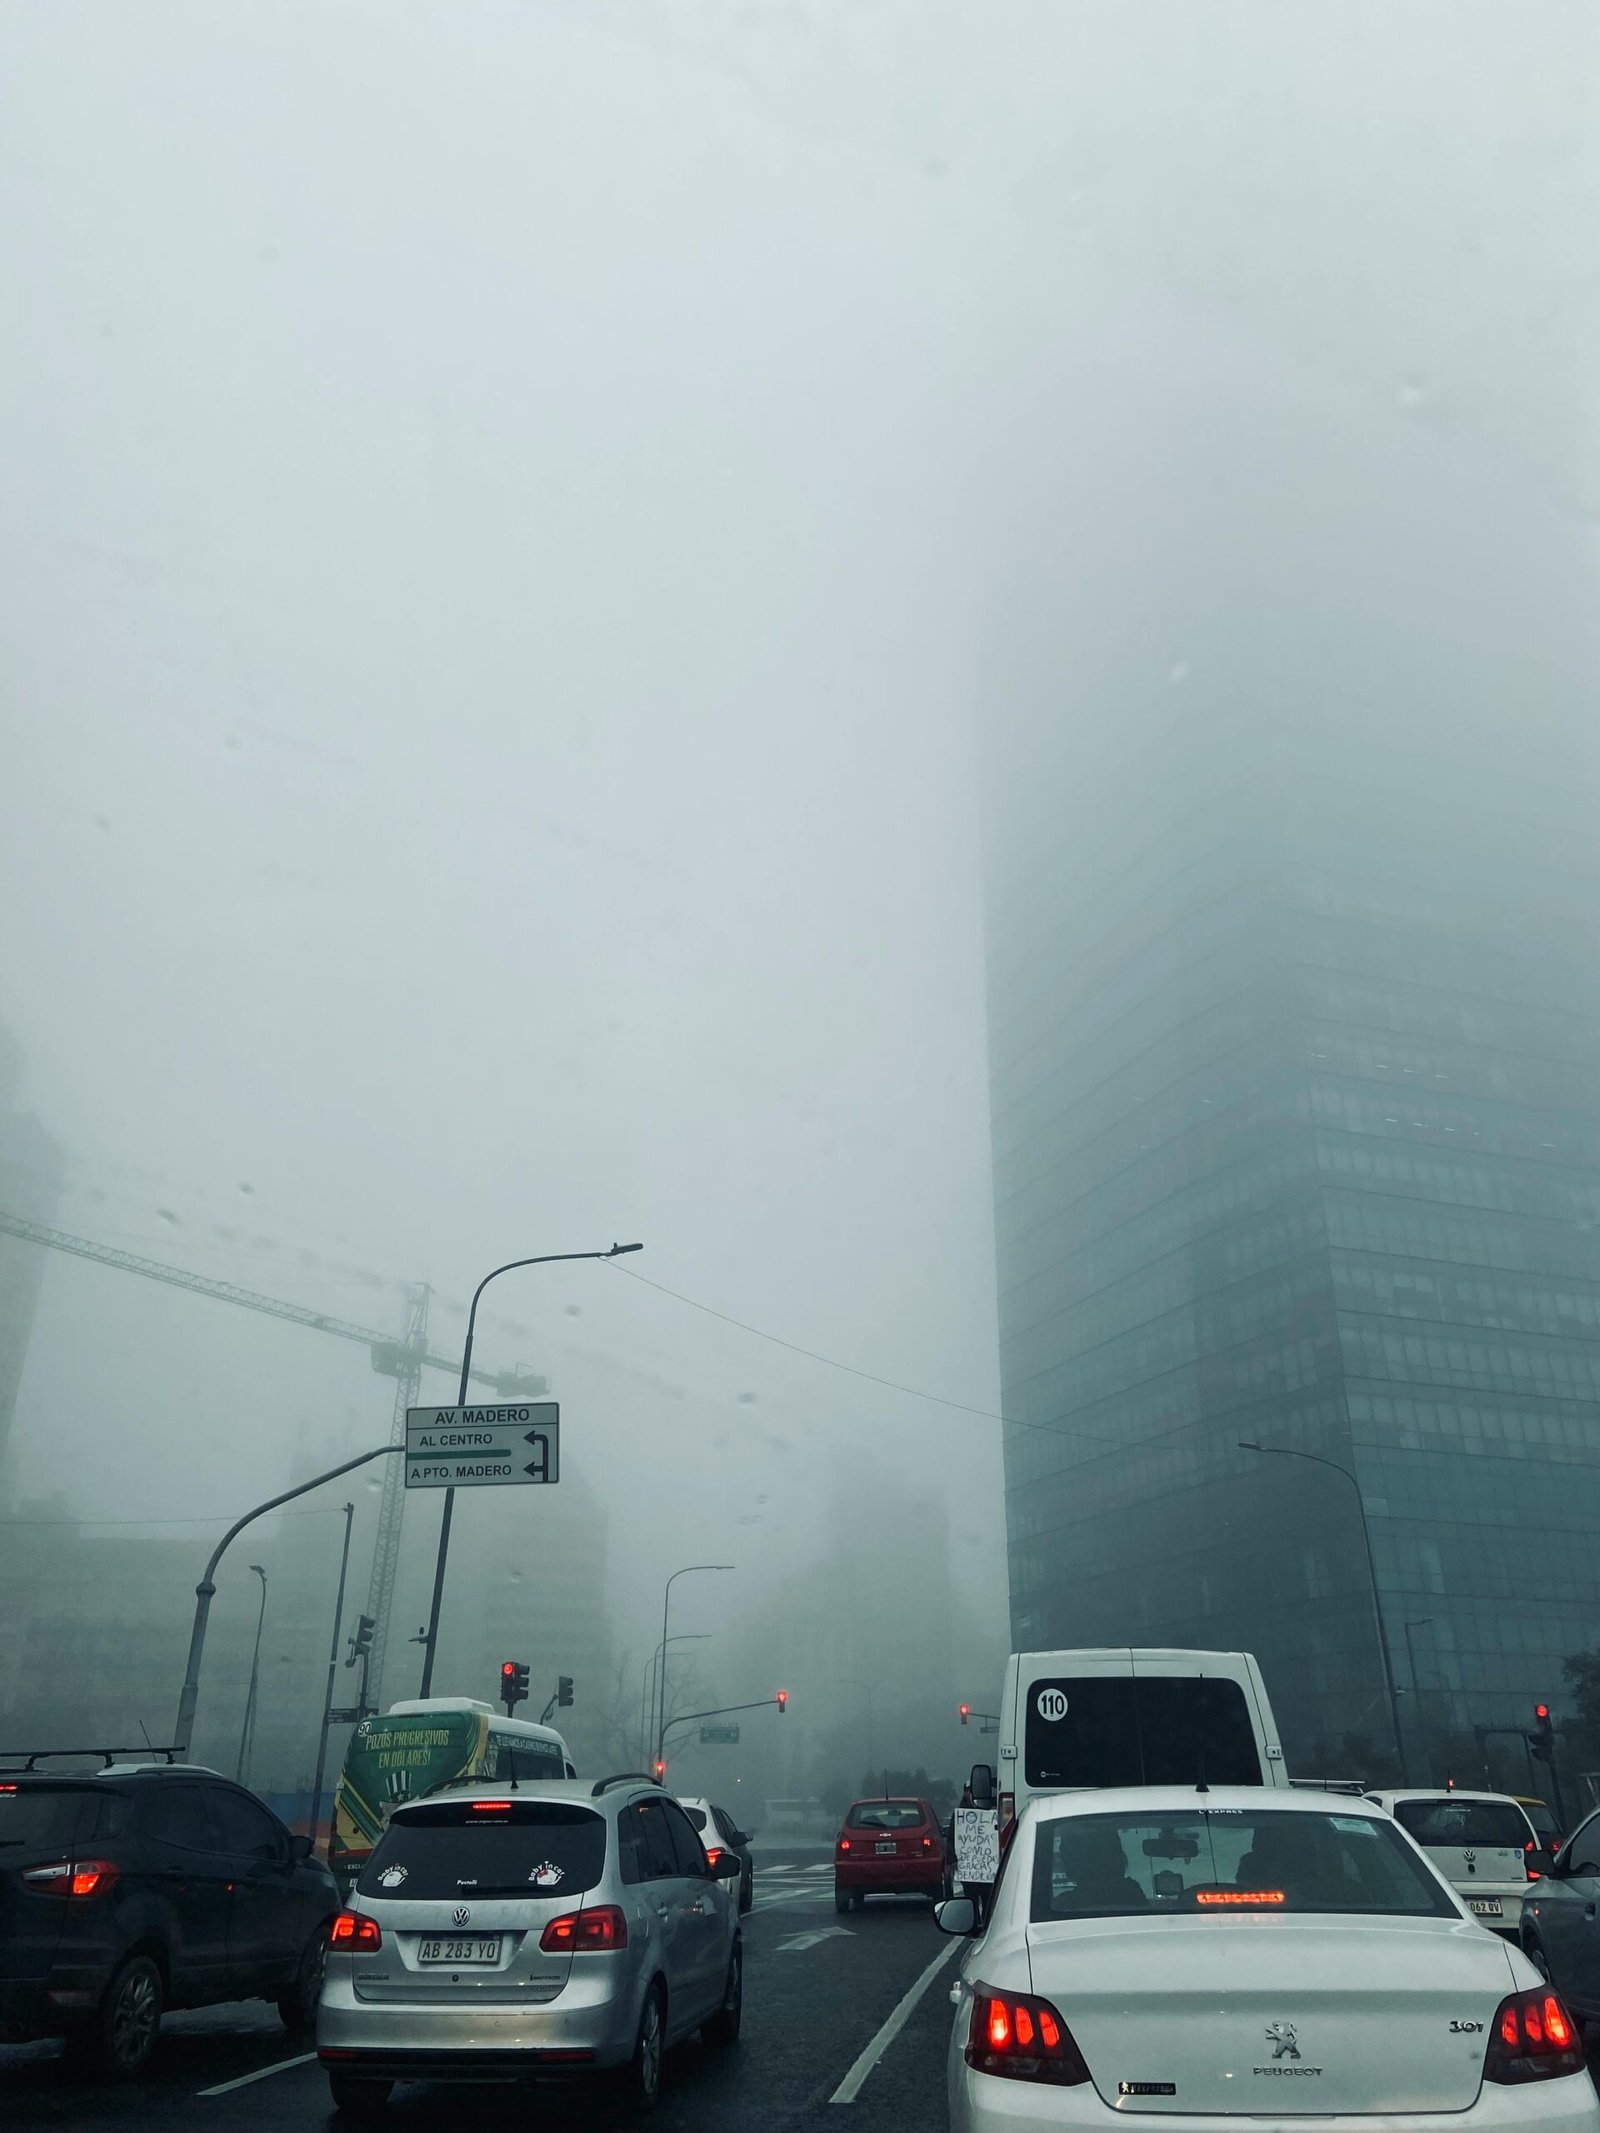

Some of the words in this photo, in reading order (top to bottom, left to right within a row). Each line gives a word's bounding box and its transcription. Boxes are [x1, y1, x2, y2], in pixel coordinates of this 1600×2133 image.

[435, 1412, 457, 1424] AV.
[463, 1409, 530, 1423] MADERO
[420, 1436, 436, 1446] AL
[440, 1434, 493, 1446] CENTRO
[411, 1469, 420, 1479] A
[424, 1467, 452, 1478] PTO.
[457, 1465, 512, 1477] MADERO
[1041, 1695, 1065, 1714] 110
[359, 1723, 371, 1735] 90
[366, 1732, 392, 1751] POZOS
[393, 1729, 450, 1746] PROGRESIVOS
[378, 1751, 390, 1769] EN
[957, 1810, 998, 1825] HOLA
[965, 1824, 985, 1835] ME
[422, 1944, 440, 1958] AB
[445, 1943, 475, 1958] 283
[478, 1943, 497, 1958] YO
[1449, 2020, 1484, 2033] 301
[1253, 2067, 1323, 2076] PEUGEOT
